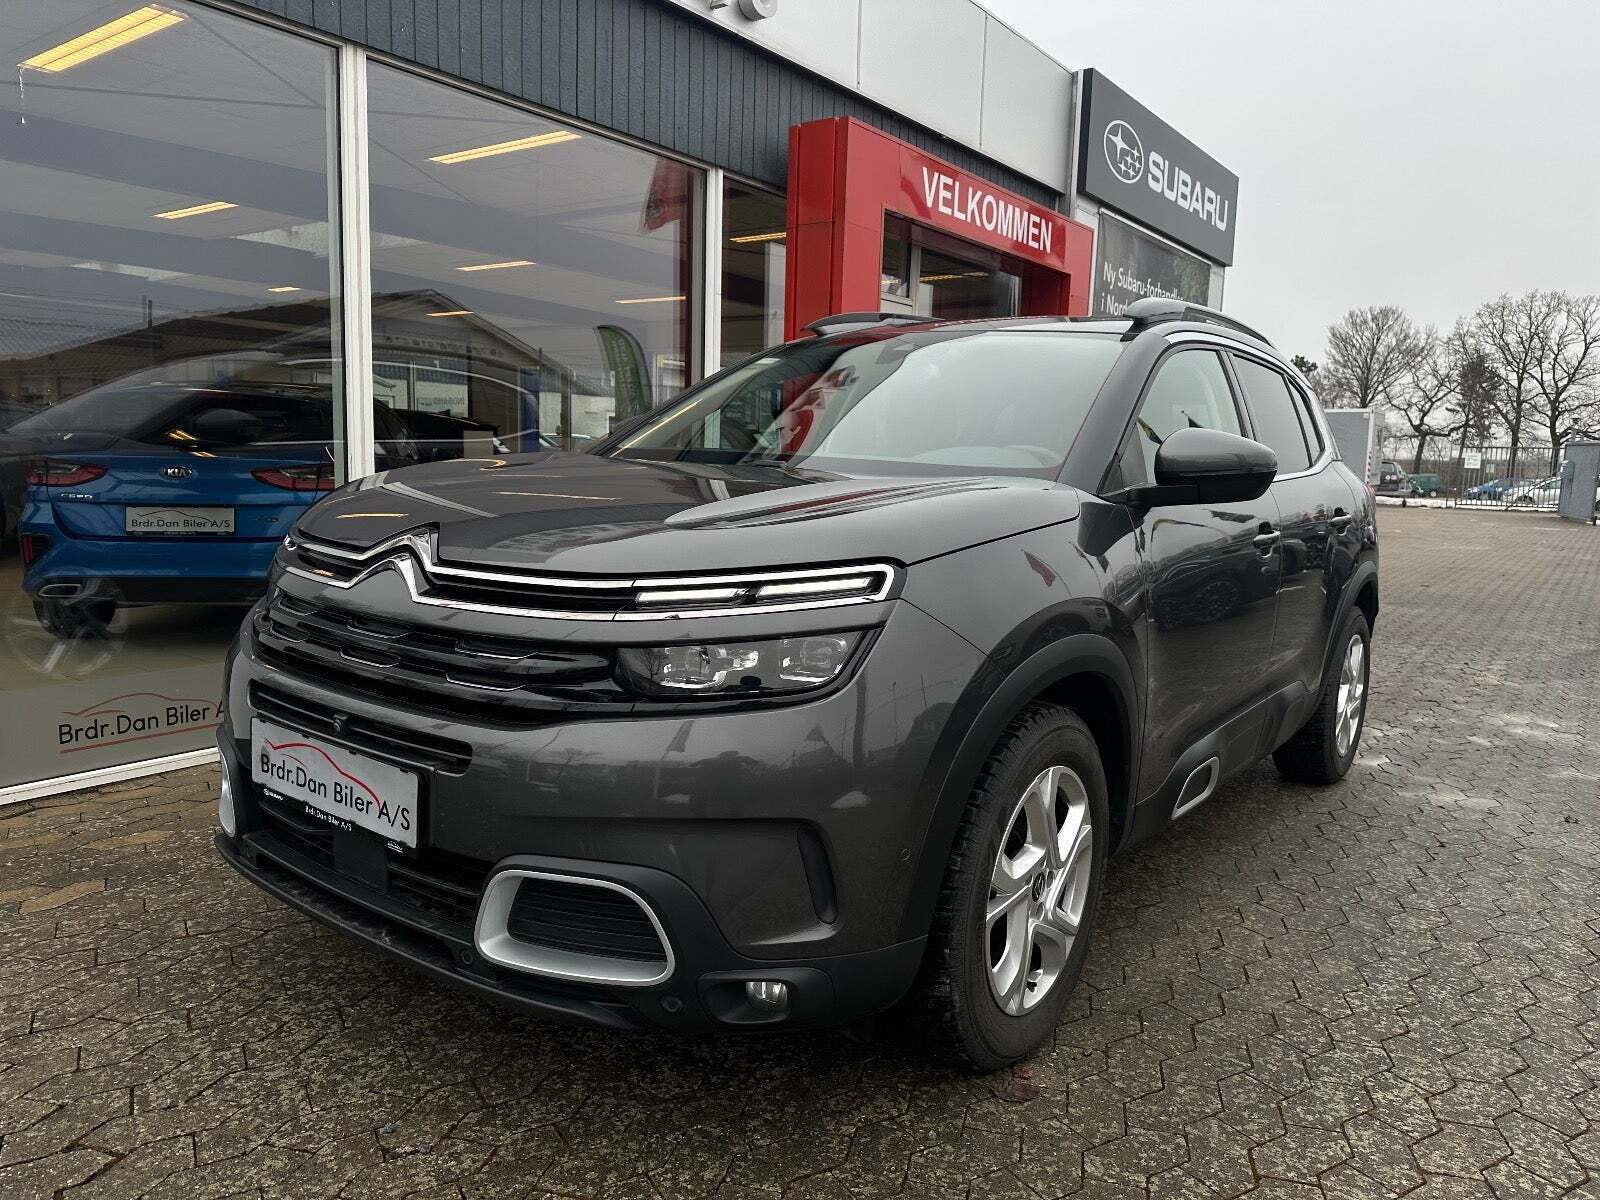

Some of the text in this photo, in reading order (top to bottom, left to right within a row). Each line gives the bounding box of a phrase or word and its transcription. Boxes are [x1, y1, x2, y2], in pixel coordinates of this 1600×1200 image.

[1148, 151, 1228, 232] SUBARU
[922, 166, 1052, 253] VELKOMMEN
[1103, 261, 1117, 289] Ny
[1101, 292, 1105, 311] i
[167, 468, 187, 477] KIA
[131, 518, 231, 529] Brdr.Dan Biler A/S
[58, 715, 159, 745] Brdr.Dan
[166, 704, 210, 726] Biler
[260, 753, 411, 831] Brdr.Dan Biler A/S
